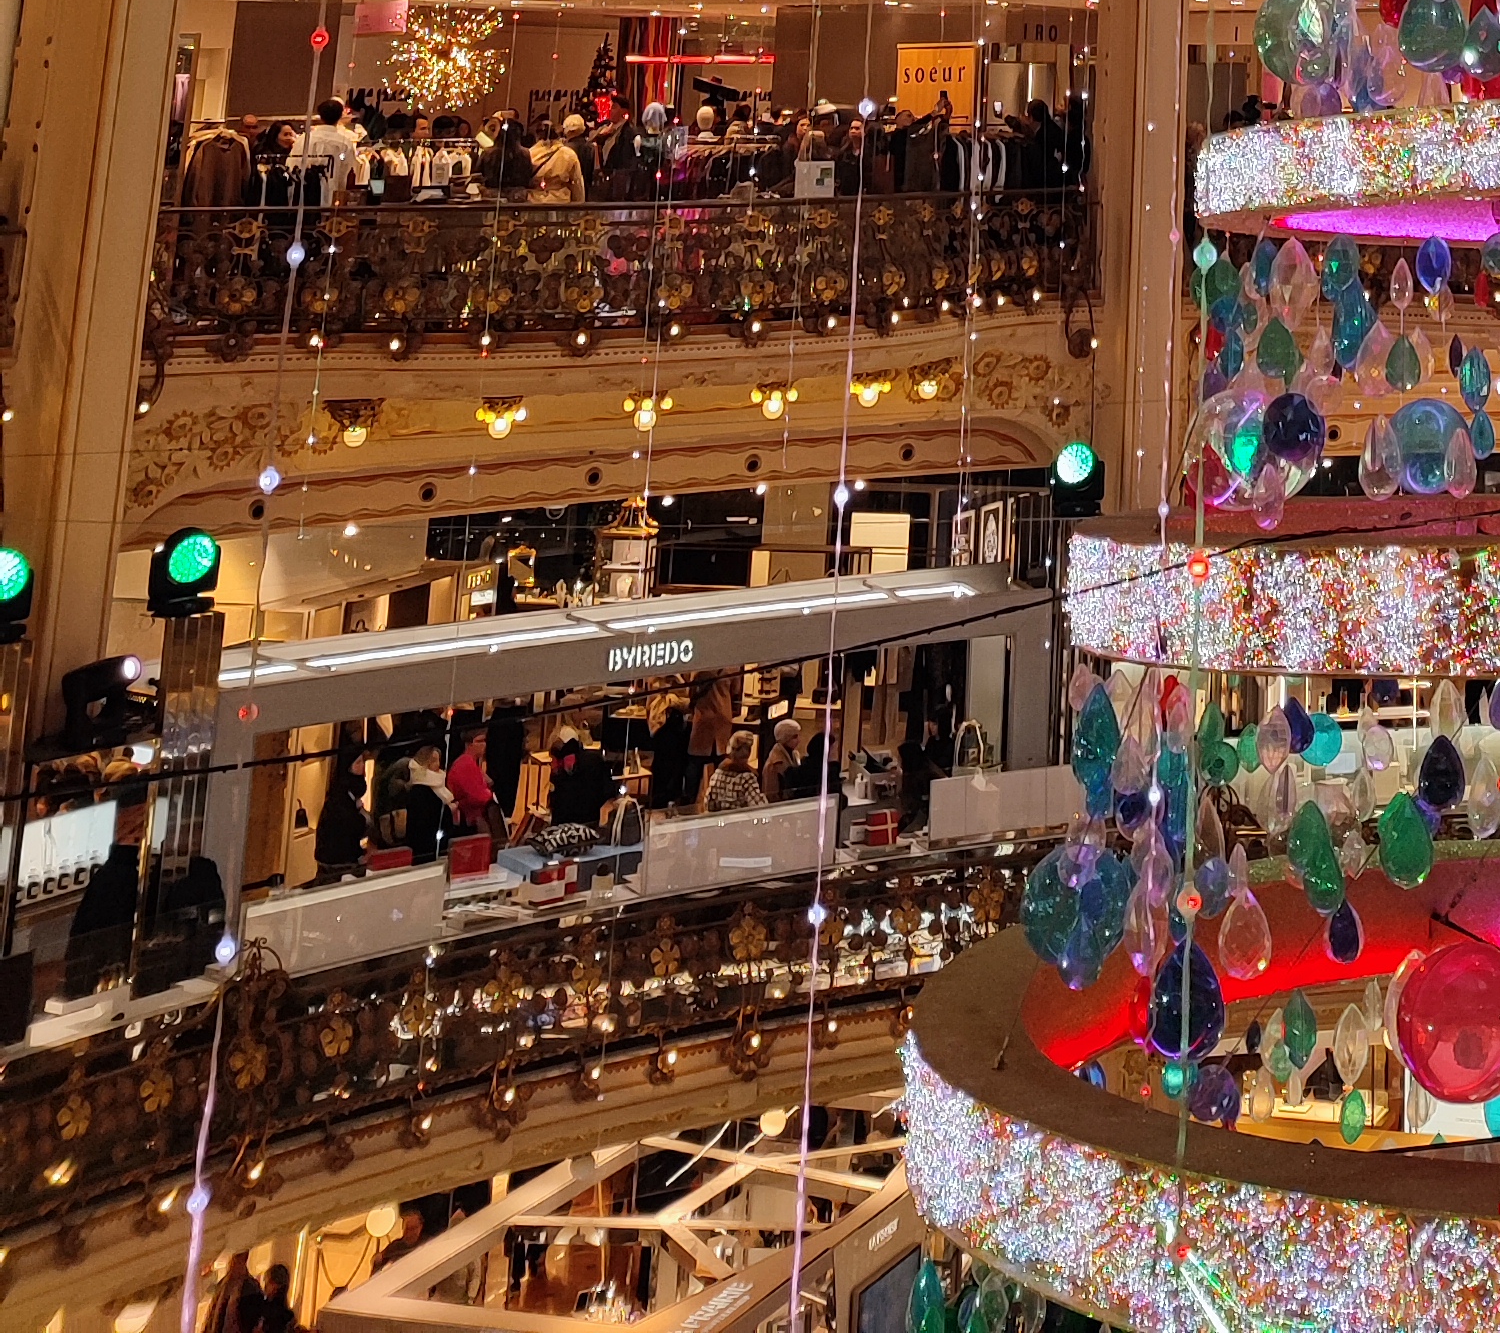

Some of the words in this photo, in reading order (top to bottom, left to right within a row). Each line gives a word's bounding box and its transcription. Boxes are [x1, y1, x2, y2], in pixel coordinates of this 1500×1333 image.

[1024, 23, 1057, 42] IRO
[903, 64, 966, 84] soeur
[608, 639, 694, 672] BYREDO
